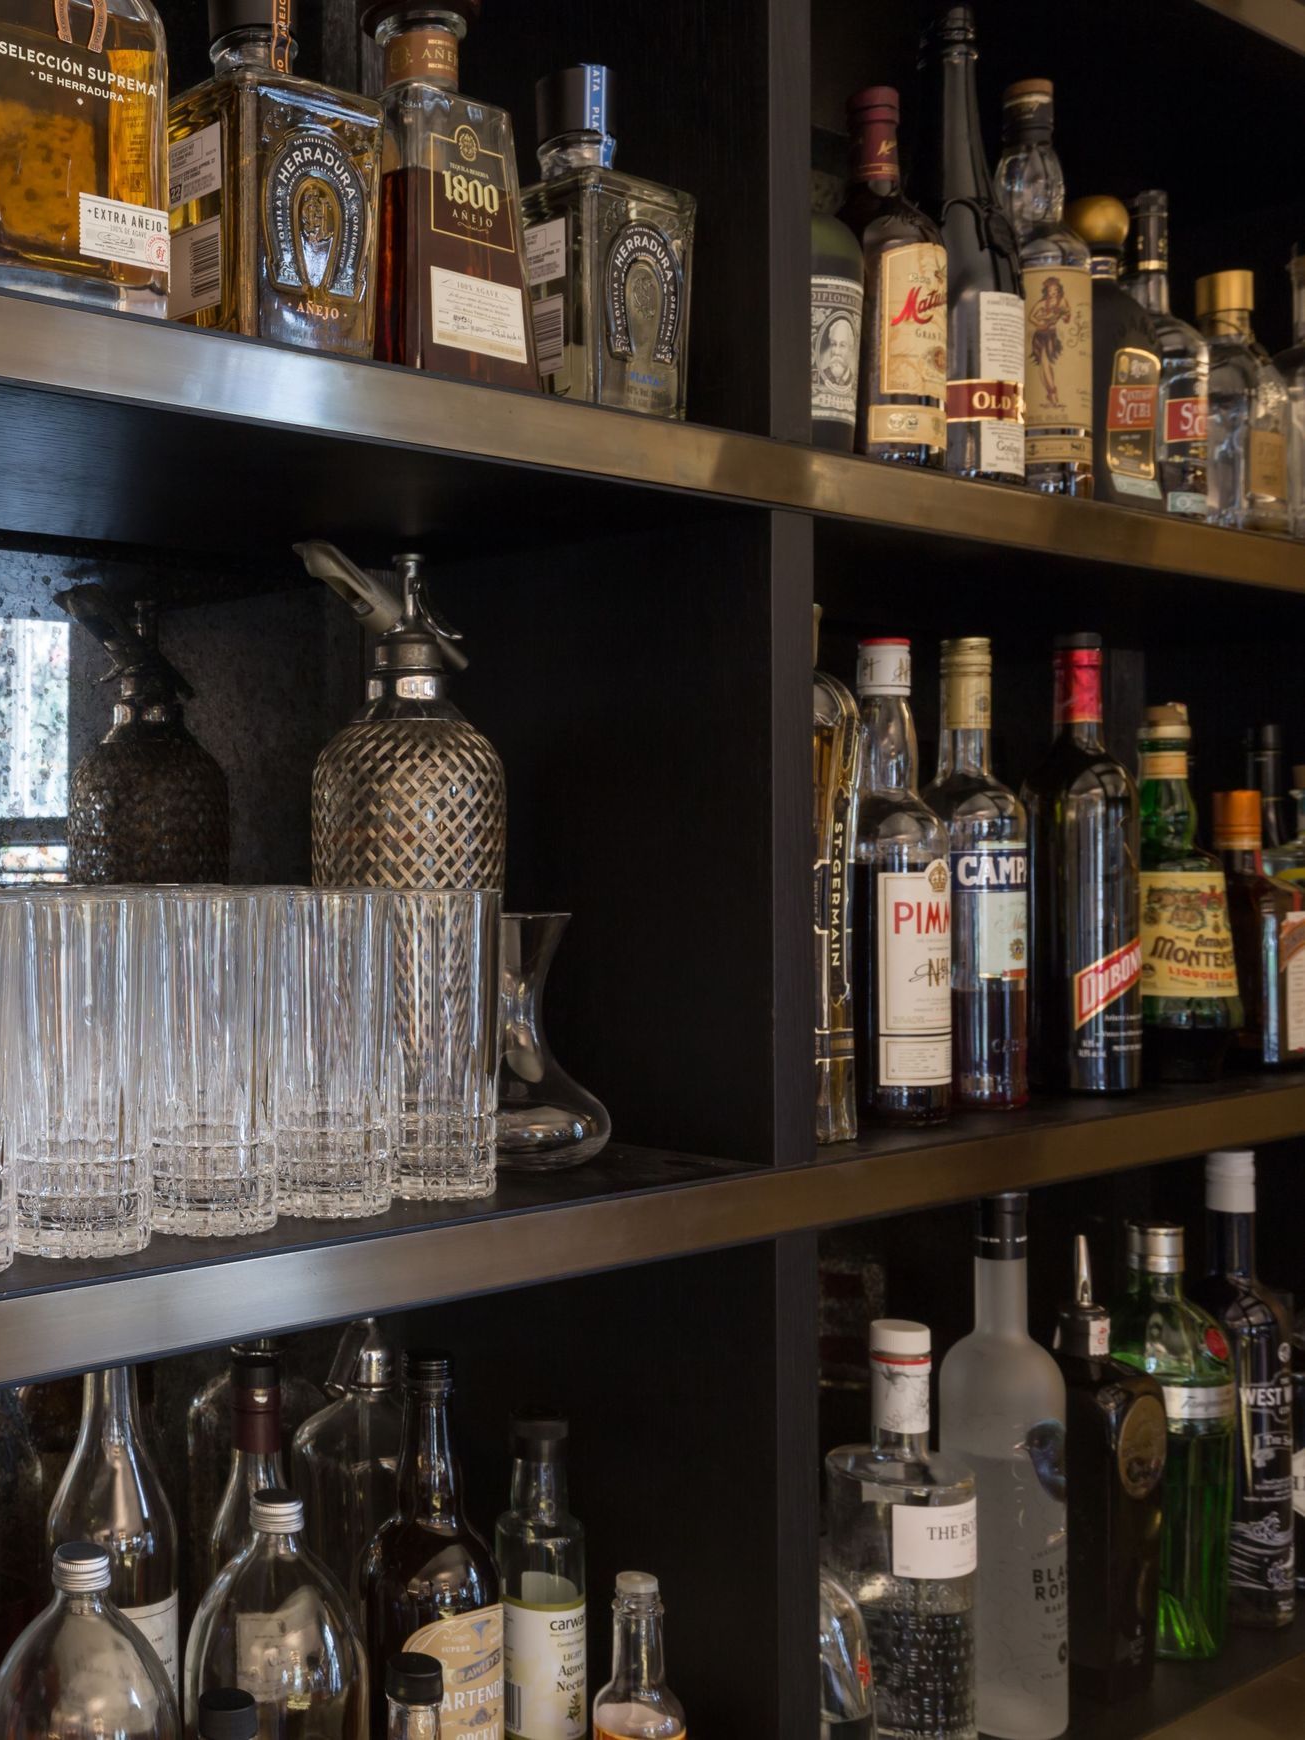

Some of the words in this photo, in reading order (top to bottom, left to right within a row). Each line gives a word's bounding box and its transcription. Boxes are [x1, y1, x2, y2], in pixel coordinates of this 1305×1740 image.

[38, 71, 54, 84] DE
[56, 76, 125, 104] HERRADURA
[87, 66, 158, 98] SUPREMA
[278, 146, 357, 201] HERRADURA
[442, 169, 500, 216] 1800
[94, 207, 127, 226] EXTRA
[131, 215, 162, 233] AÑEJO
[452, 208, 493, 228] AÑEJO
[614, 235, 674, 282] HERRADURA
[296, 300, 340, 321] AÑEJO
[612, 282, 623, 332] TEQUILA
[972, 390, 1012, 411] OLD
[957, 855, 1027, 887] CAMP
[1240, 1386, 1283, 1407] WEST
[926, 1524, 959, 1541] THE
[549, 1614, 585, 1632] carwa
